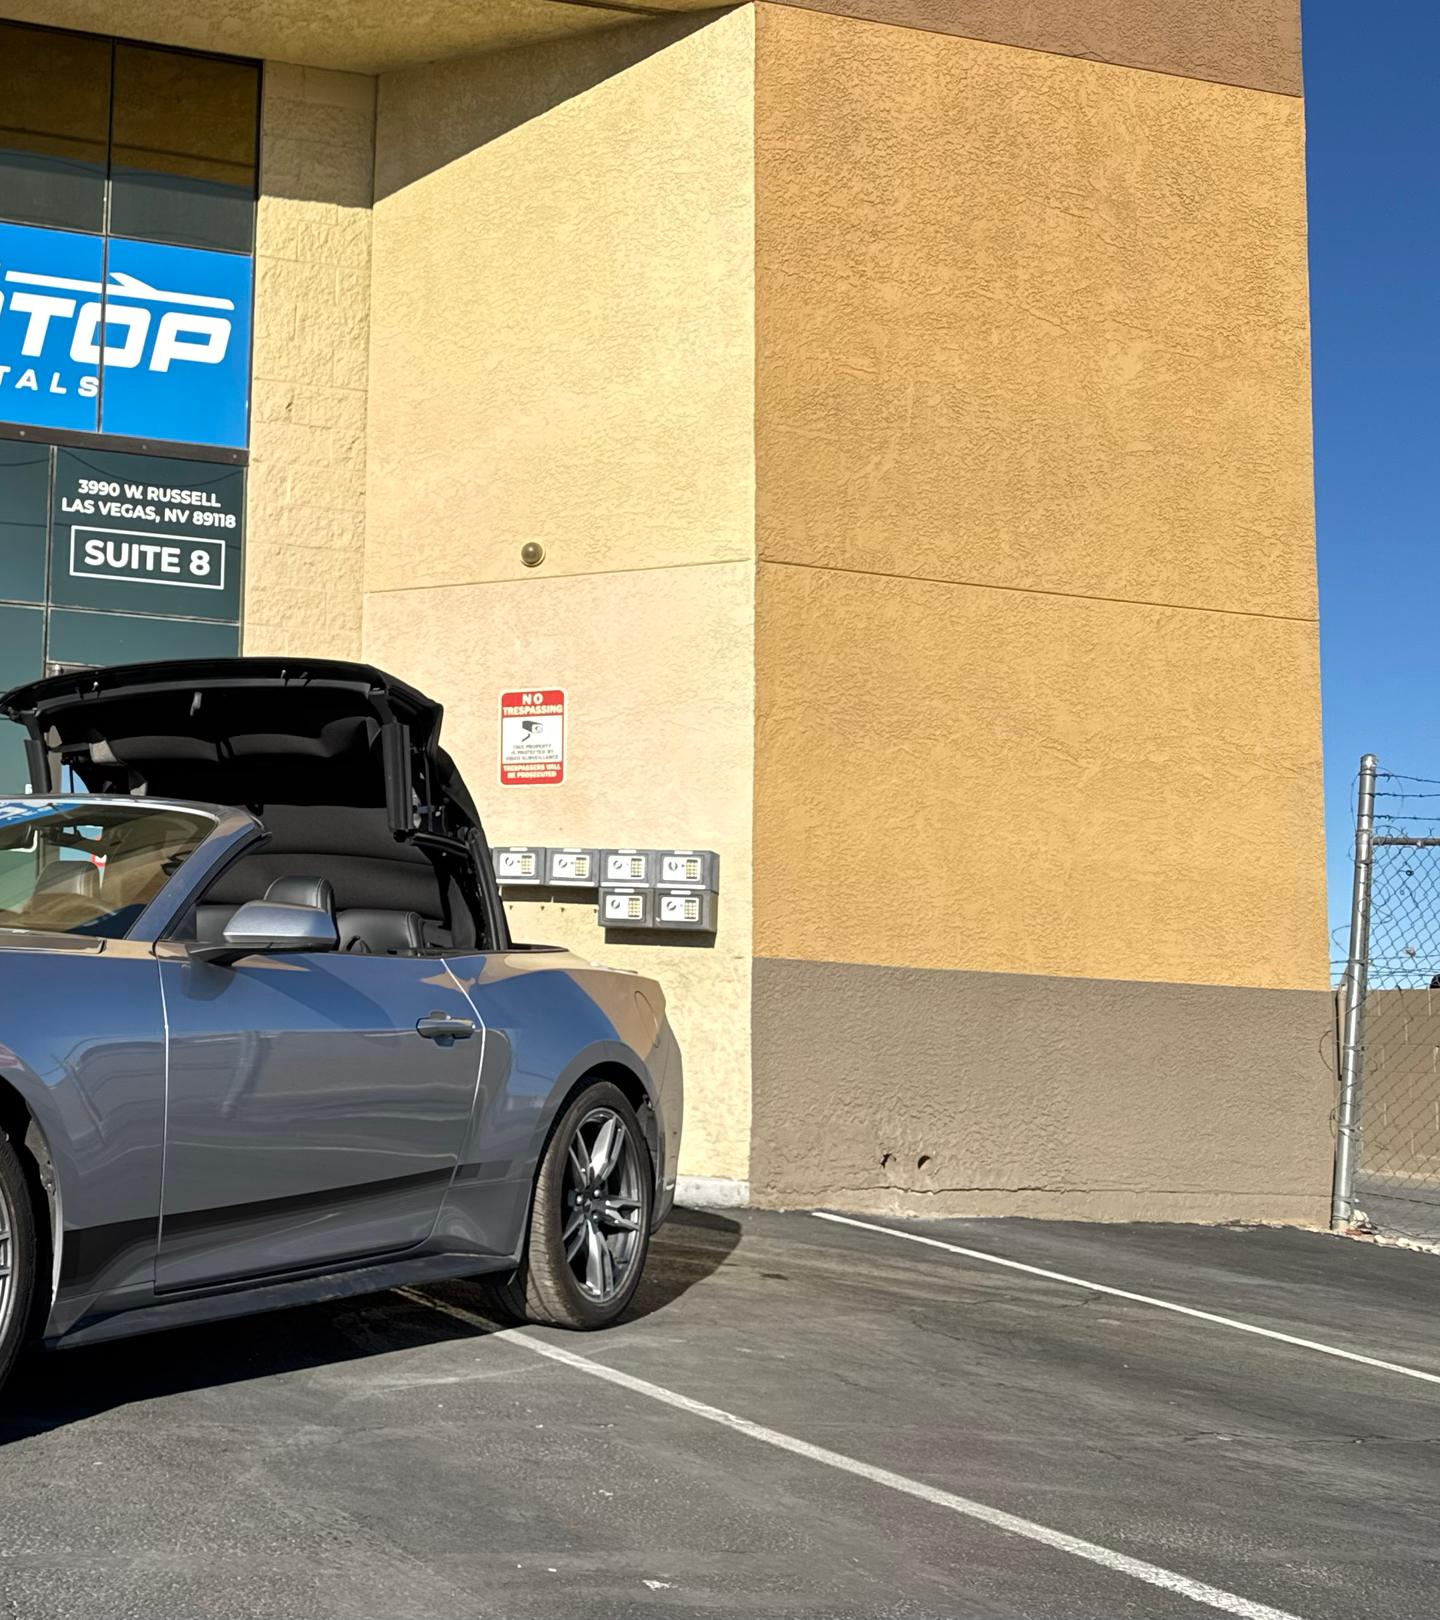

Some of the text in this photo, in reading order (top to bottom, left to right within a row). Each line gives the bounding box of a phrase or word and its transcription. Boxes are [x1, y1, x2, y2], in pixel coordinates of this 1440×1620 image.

[78, 479, 120, 497] 3990
[147, 486, 221, 507] RUSSELL
[62, 497, 236, 528] LAS VEGAS, NV 89118
[84, 539, 210, 576] SUITE 8
[503, 704, 563, 716] TRESPASSING
[522, 693, 543, 705] NO
